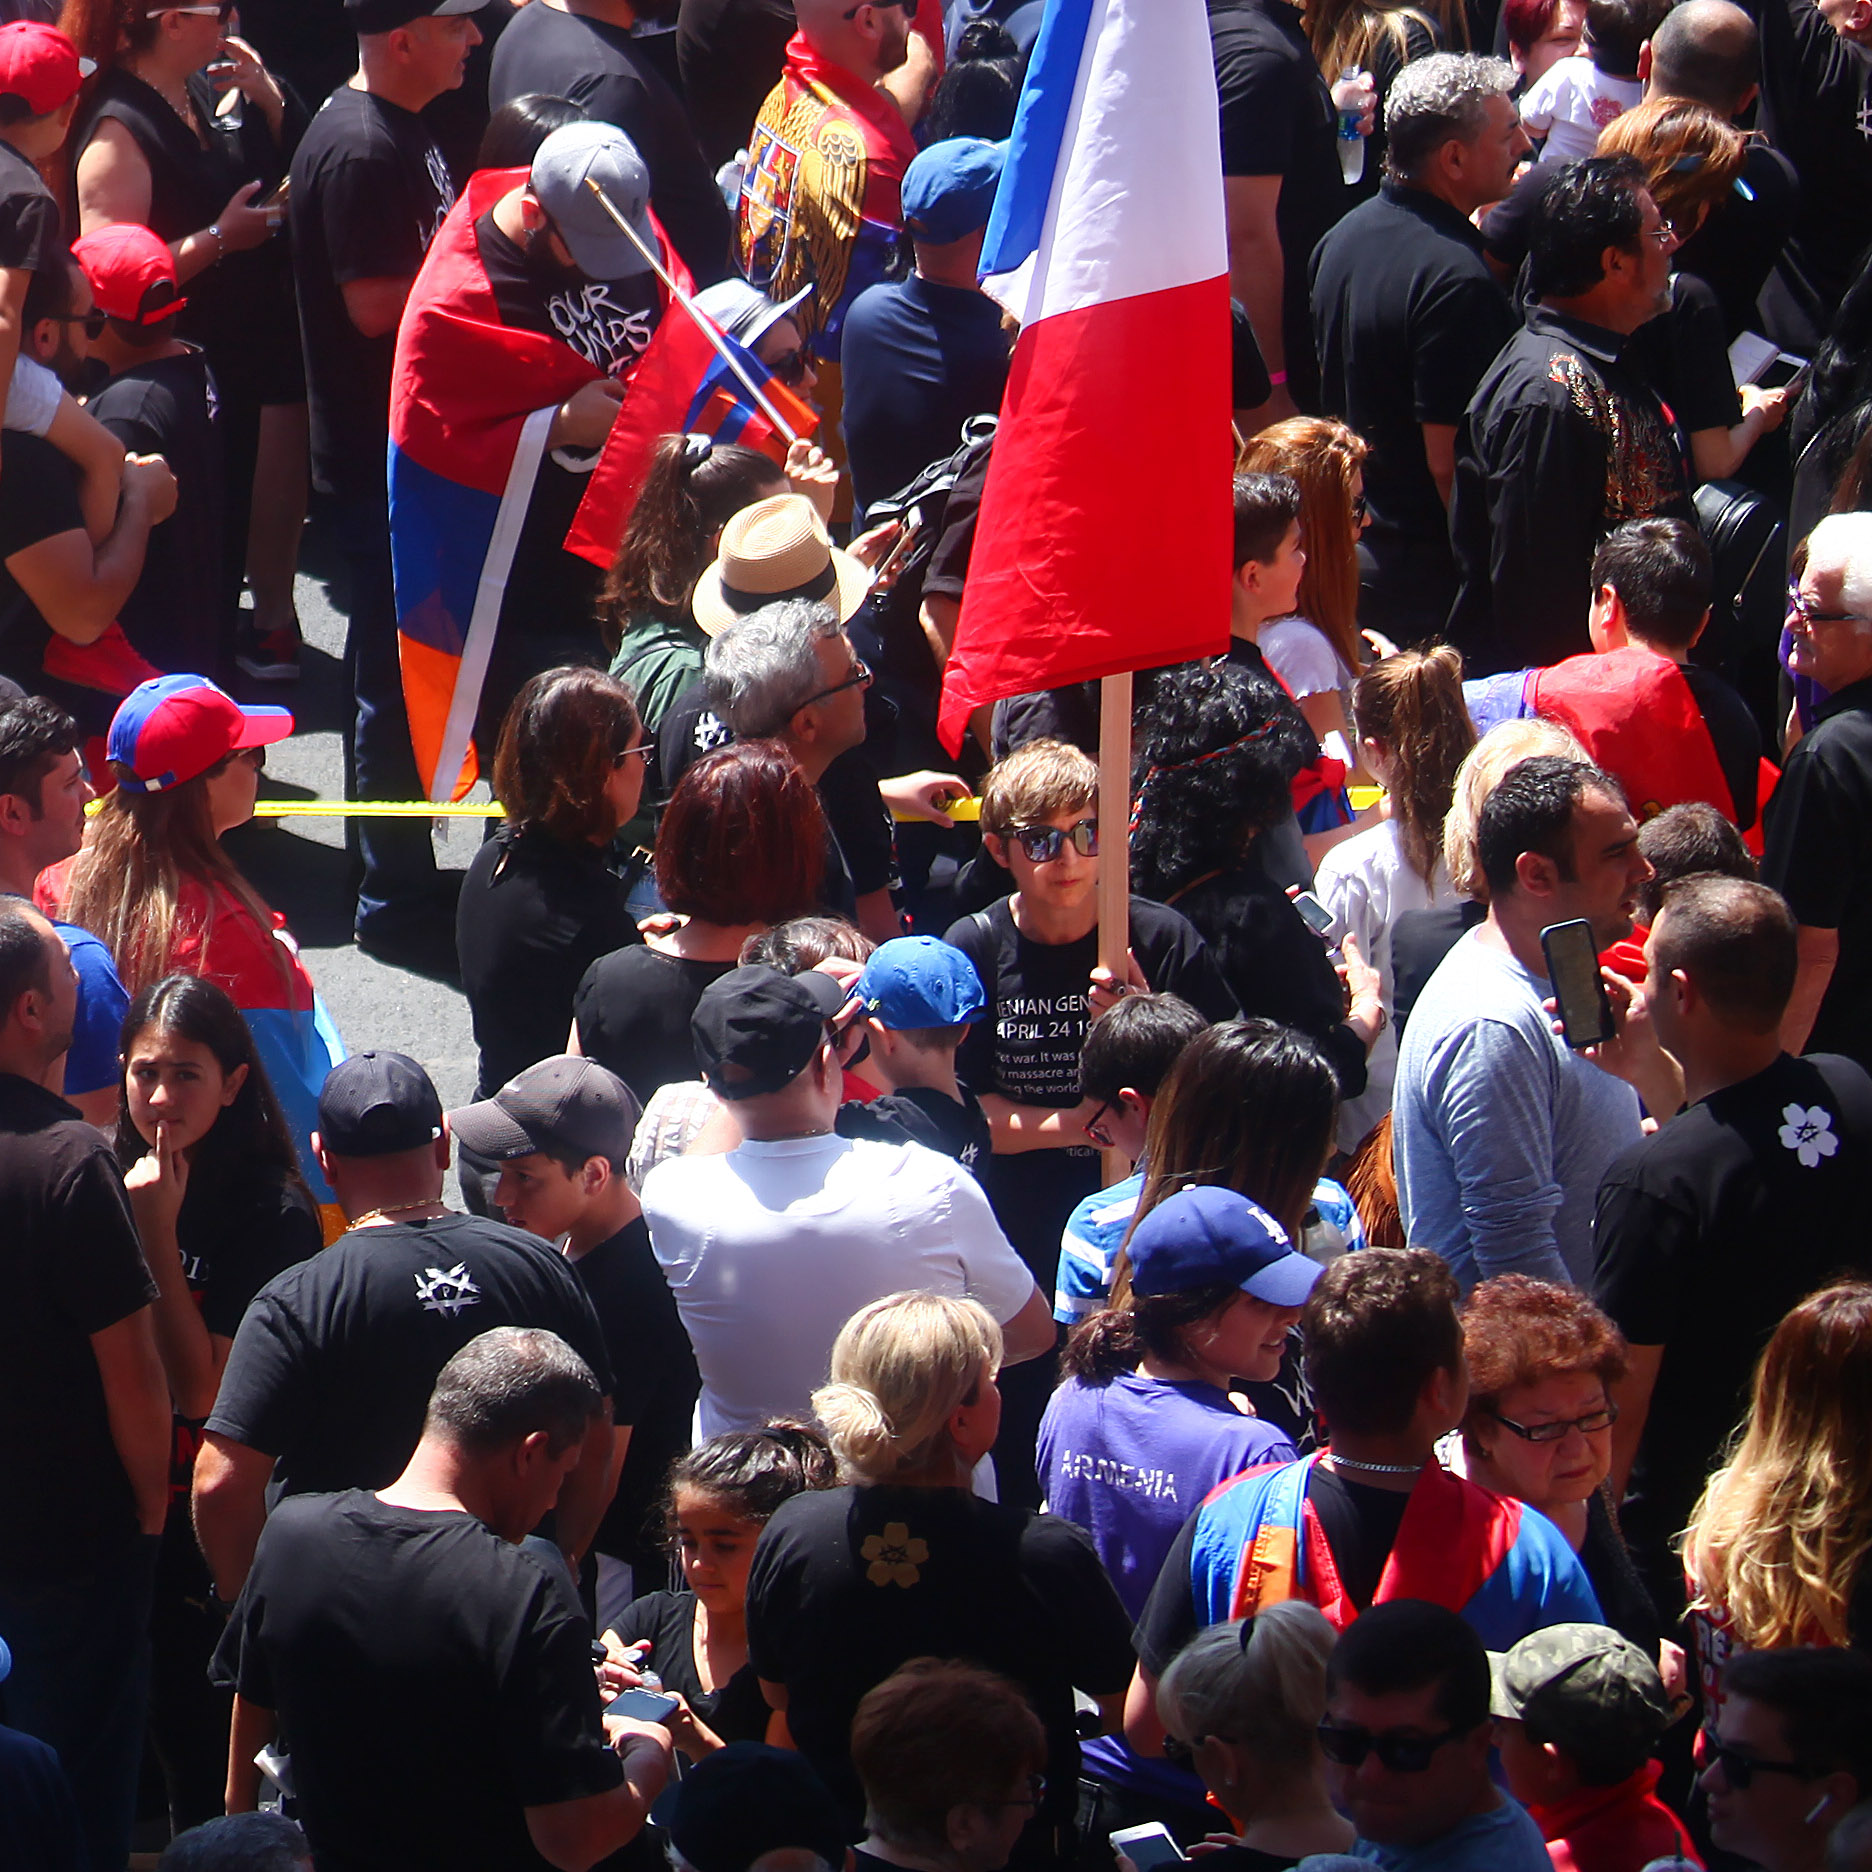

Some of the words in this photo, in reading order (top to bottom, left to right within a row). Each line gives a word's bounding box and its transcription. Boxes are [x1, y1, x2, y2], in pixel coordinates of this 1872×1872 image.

[544, 284, 631, 337] OUR
[566, 309, 651, 368] UNDS
[996, 1021, 1045, 1040] APRIL
[1049, 1021, 1071, 1038] 24
[1007, 1068, 1063, 1079] massacre
